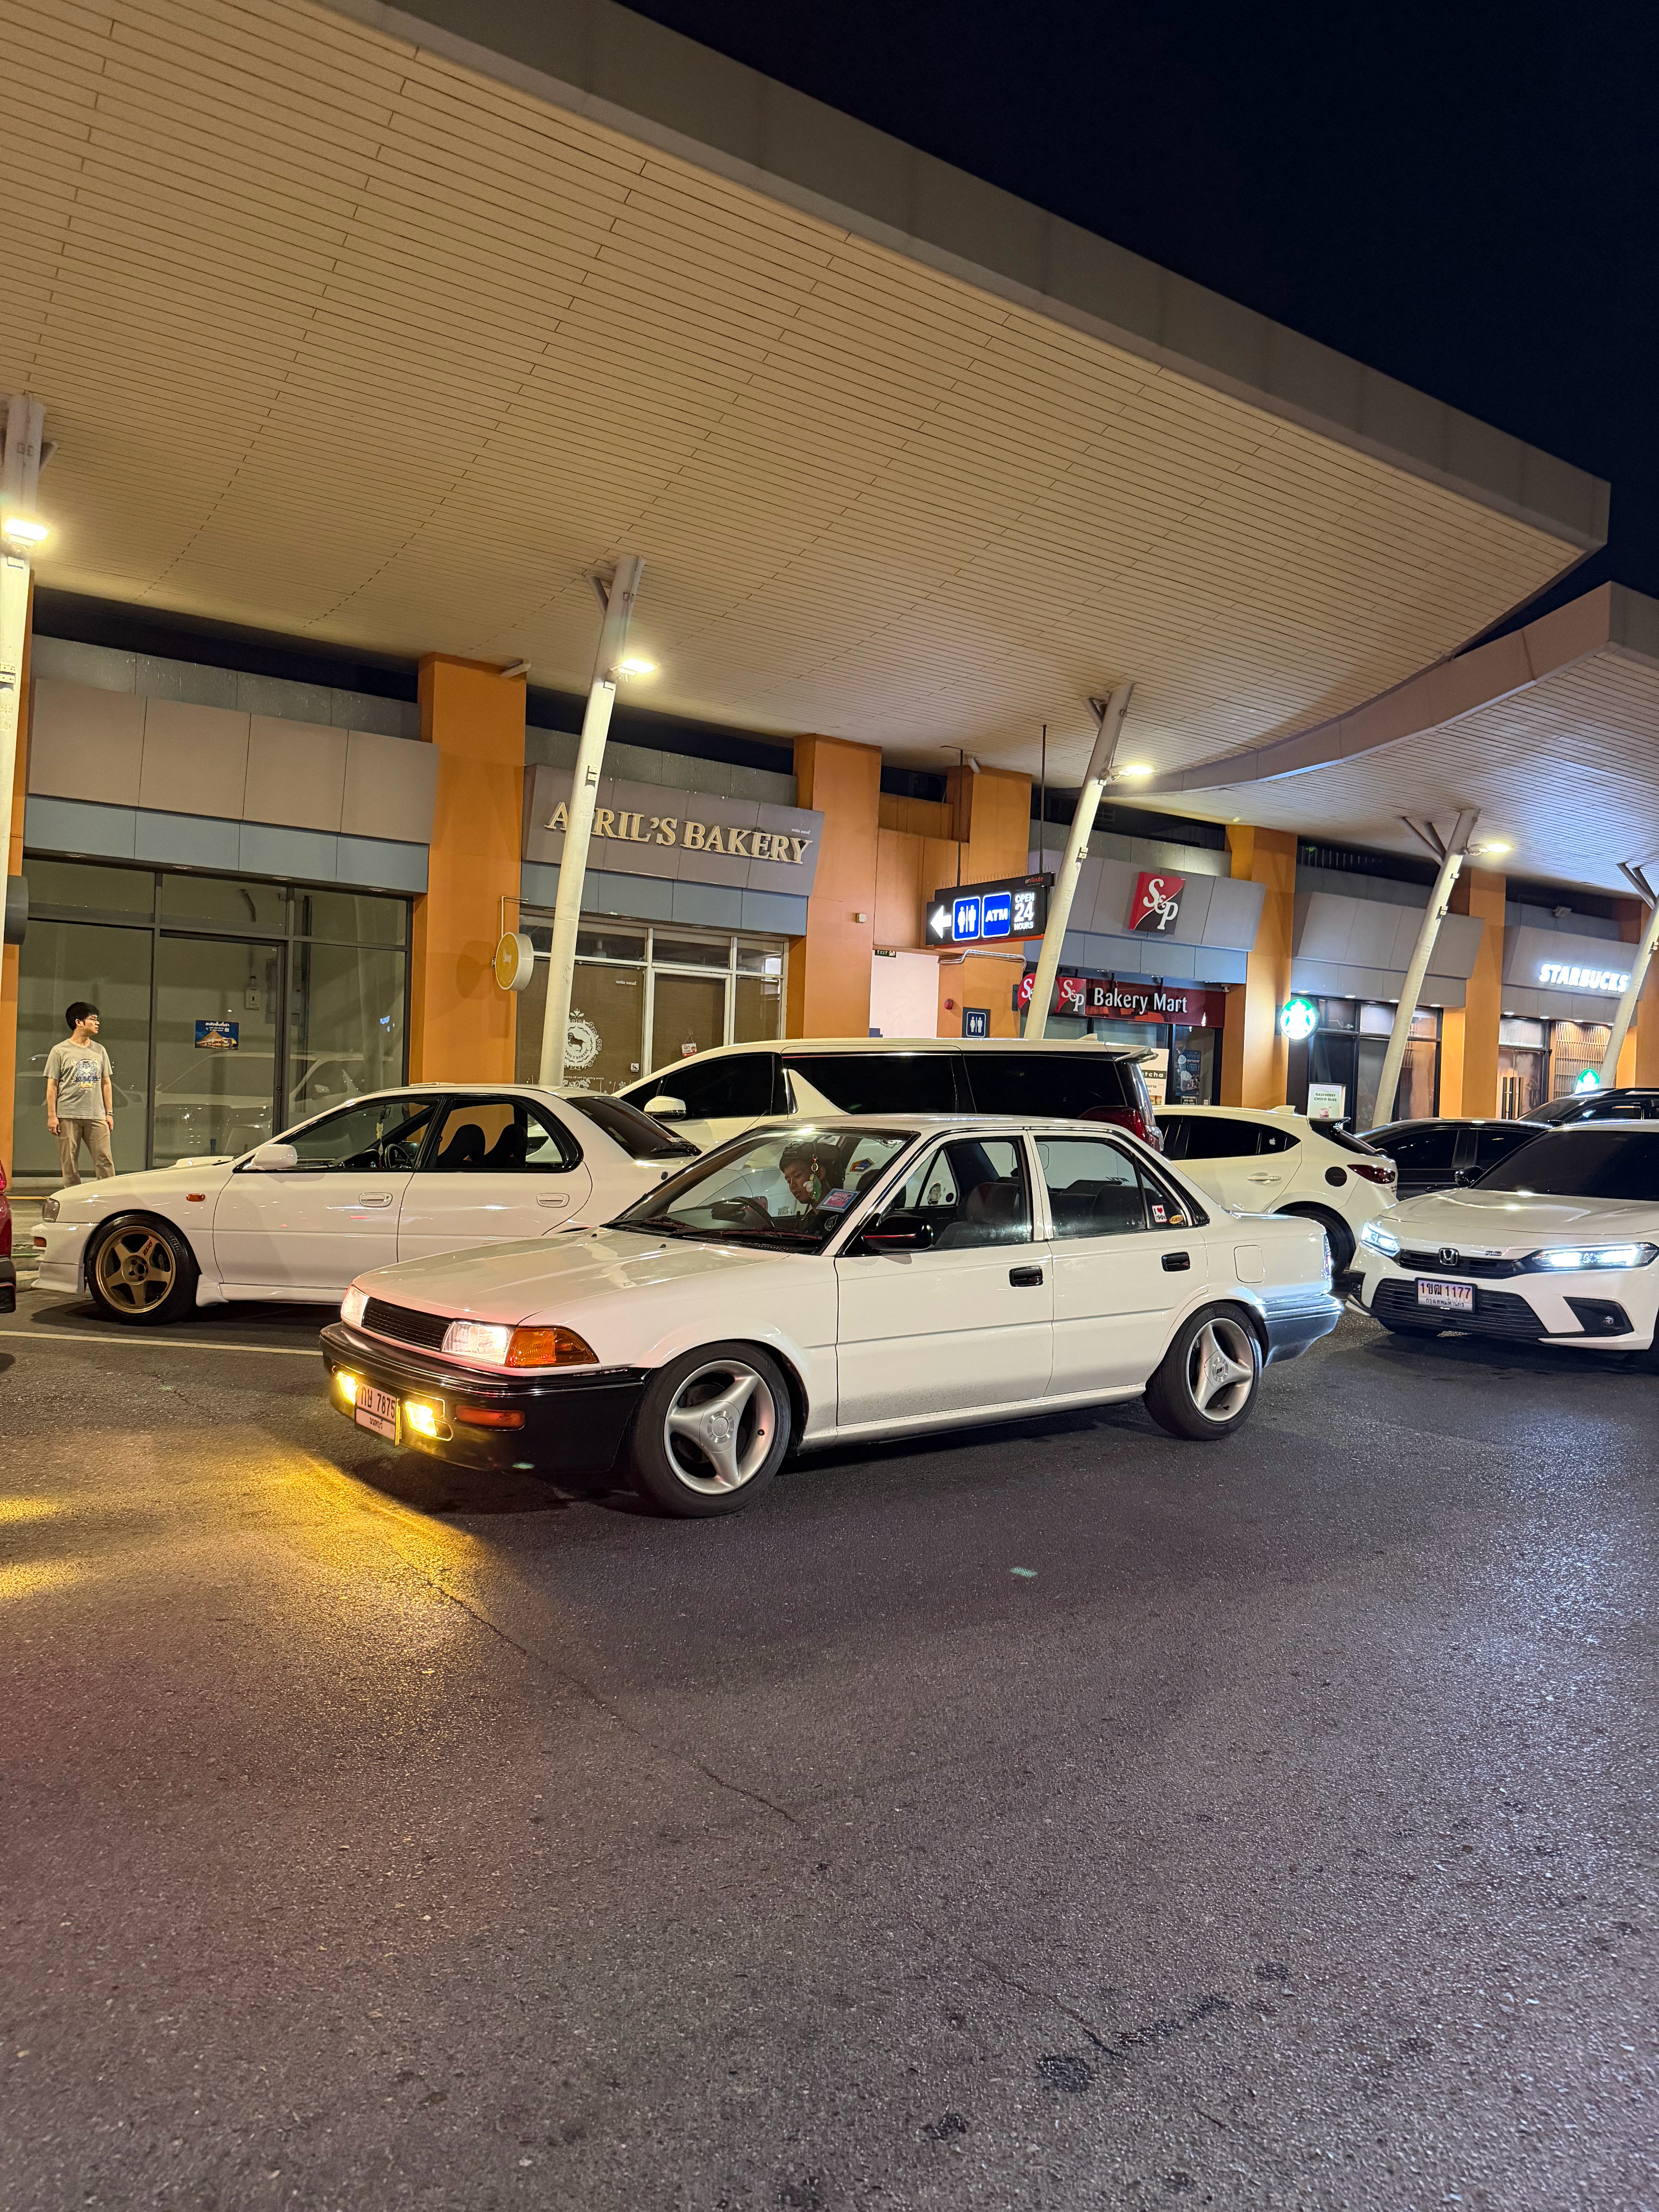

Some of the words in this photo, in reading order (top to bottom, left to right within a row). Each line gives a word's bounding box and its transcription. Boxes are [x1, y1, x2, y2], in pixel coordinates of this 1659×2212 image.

[544, 802, 677, 845] ARIL'S
[680, 820, 812, 864] BAKERY
[1015, 893, 1034, 903] OPEN
[1143, 878, 1178, 930] S&P
[985, 908, 1008, 922] ATM
[1014, 901, 1034, 922] 24
[1014, 921, 1034, 931] HOURS
[1539, 963, 1629, 993] STARBUCKS
[1061, 980, 1084, 1012] S&P
[1094, 988, 1148, 1015] Bakery
[1154, 993, 1187, 1013] Mart
[1445, 1285, 1471, 1299] 1177
[377, 1393, 395, 1419] 7875
